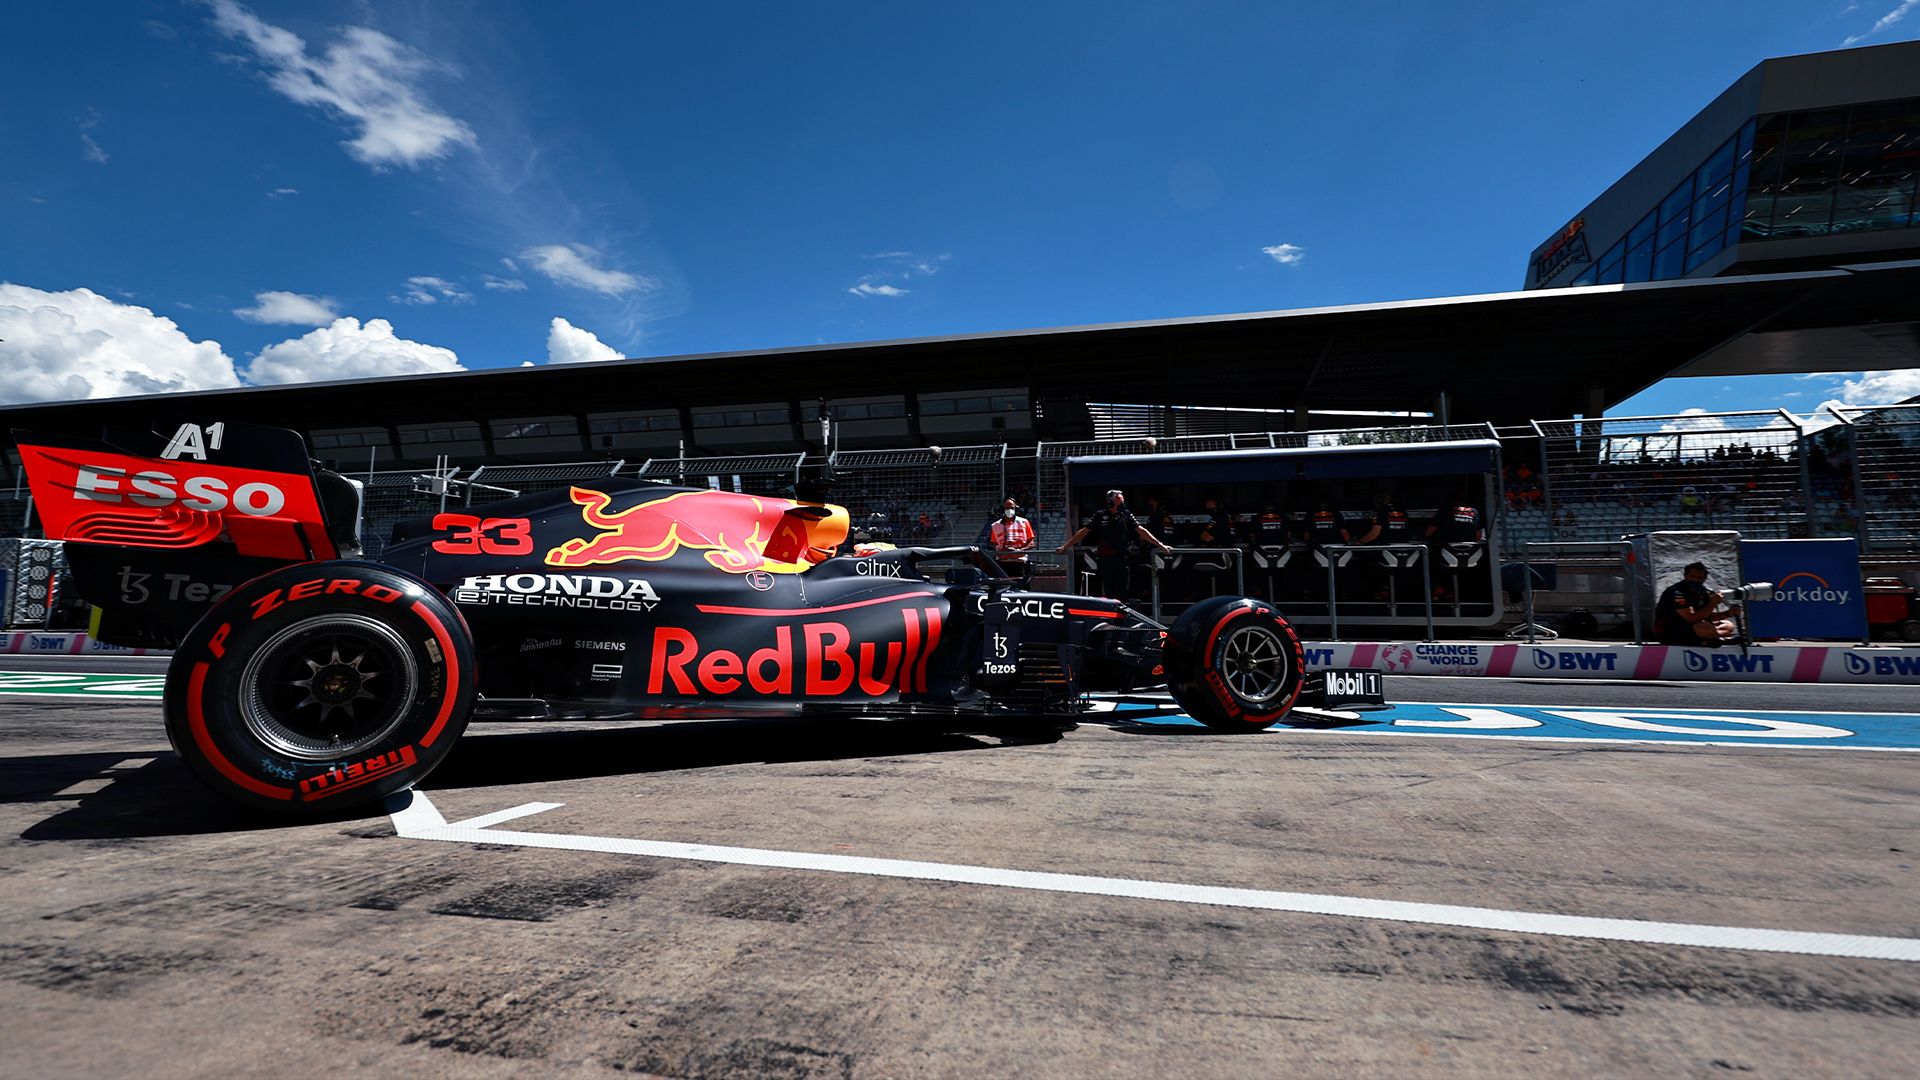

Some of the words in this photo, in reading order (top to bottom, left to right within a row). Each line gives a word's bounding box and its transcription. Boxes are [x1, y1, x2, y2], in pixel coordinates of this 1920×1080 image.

[160, 422, 224, 460] A1
[73, 464, 285, 517] ESSO
[432, 513, 534, 556] 33
[855, 558, 902, 578] citrix
[164, 573, 233, 602] Tez
[459, 573, 661, 601] HONDA
[1772, 586, 1849, 605] orkday
[977, 595, 1065, 619] OCLE
[208, 623, 231, 659] P
[250, 578, 404, 620] ZERO
[40, 637, 67, 650] BWT
[574, 640, 626, 651] SIEMENS
[1274, 615, 1305, 675] ZERO
[1416, 644, 1478, 656] CHANGE
[1303, 648, 1334, 666] WT
[1429, 656, 1479, 666] WORLD
[1558, 651, 1618, 671] BWT
[1711, 653, 1774, 674] BWT
[1873, 655, 1920, 676] BW
[984, 661, 1017, 675] Tezos
[1326, 671, 1364, 696] Mobil
[299, 744, 417, 802] PIRELLI
